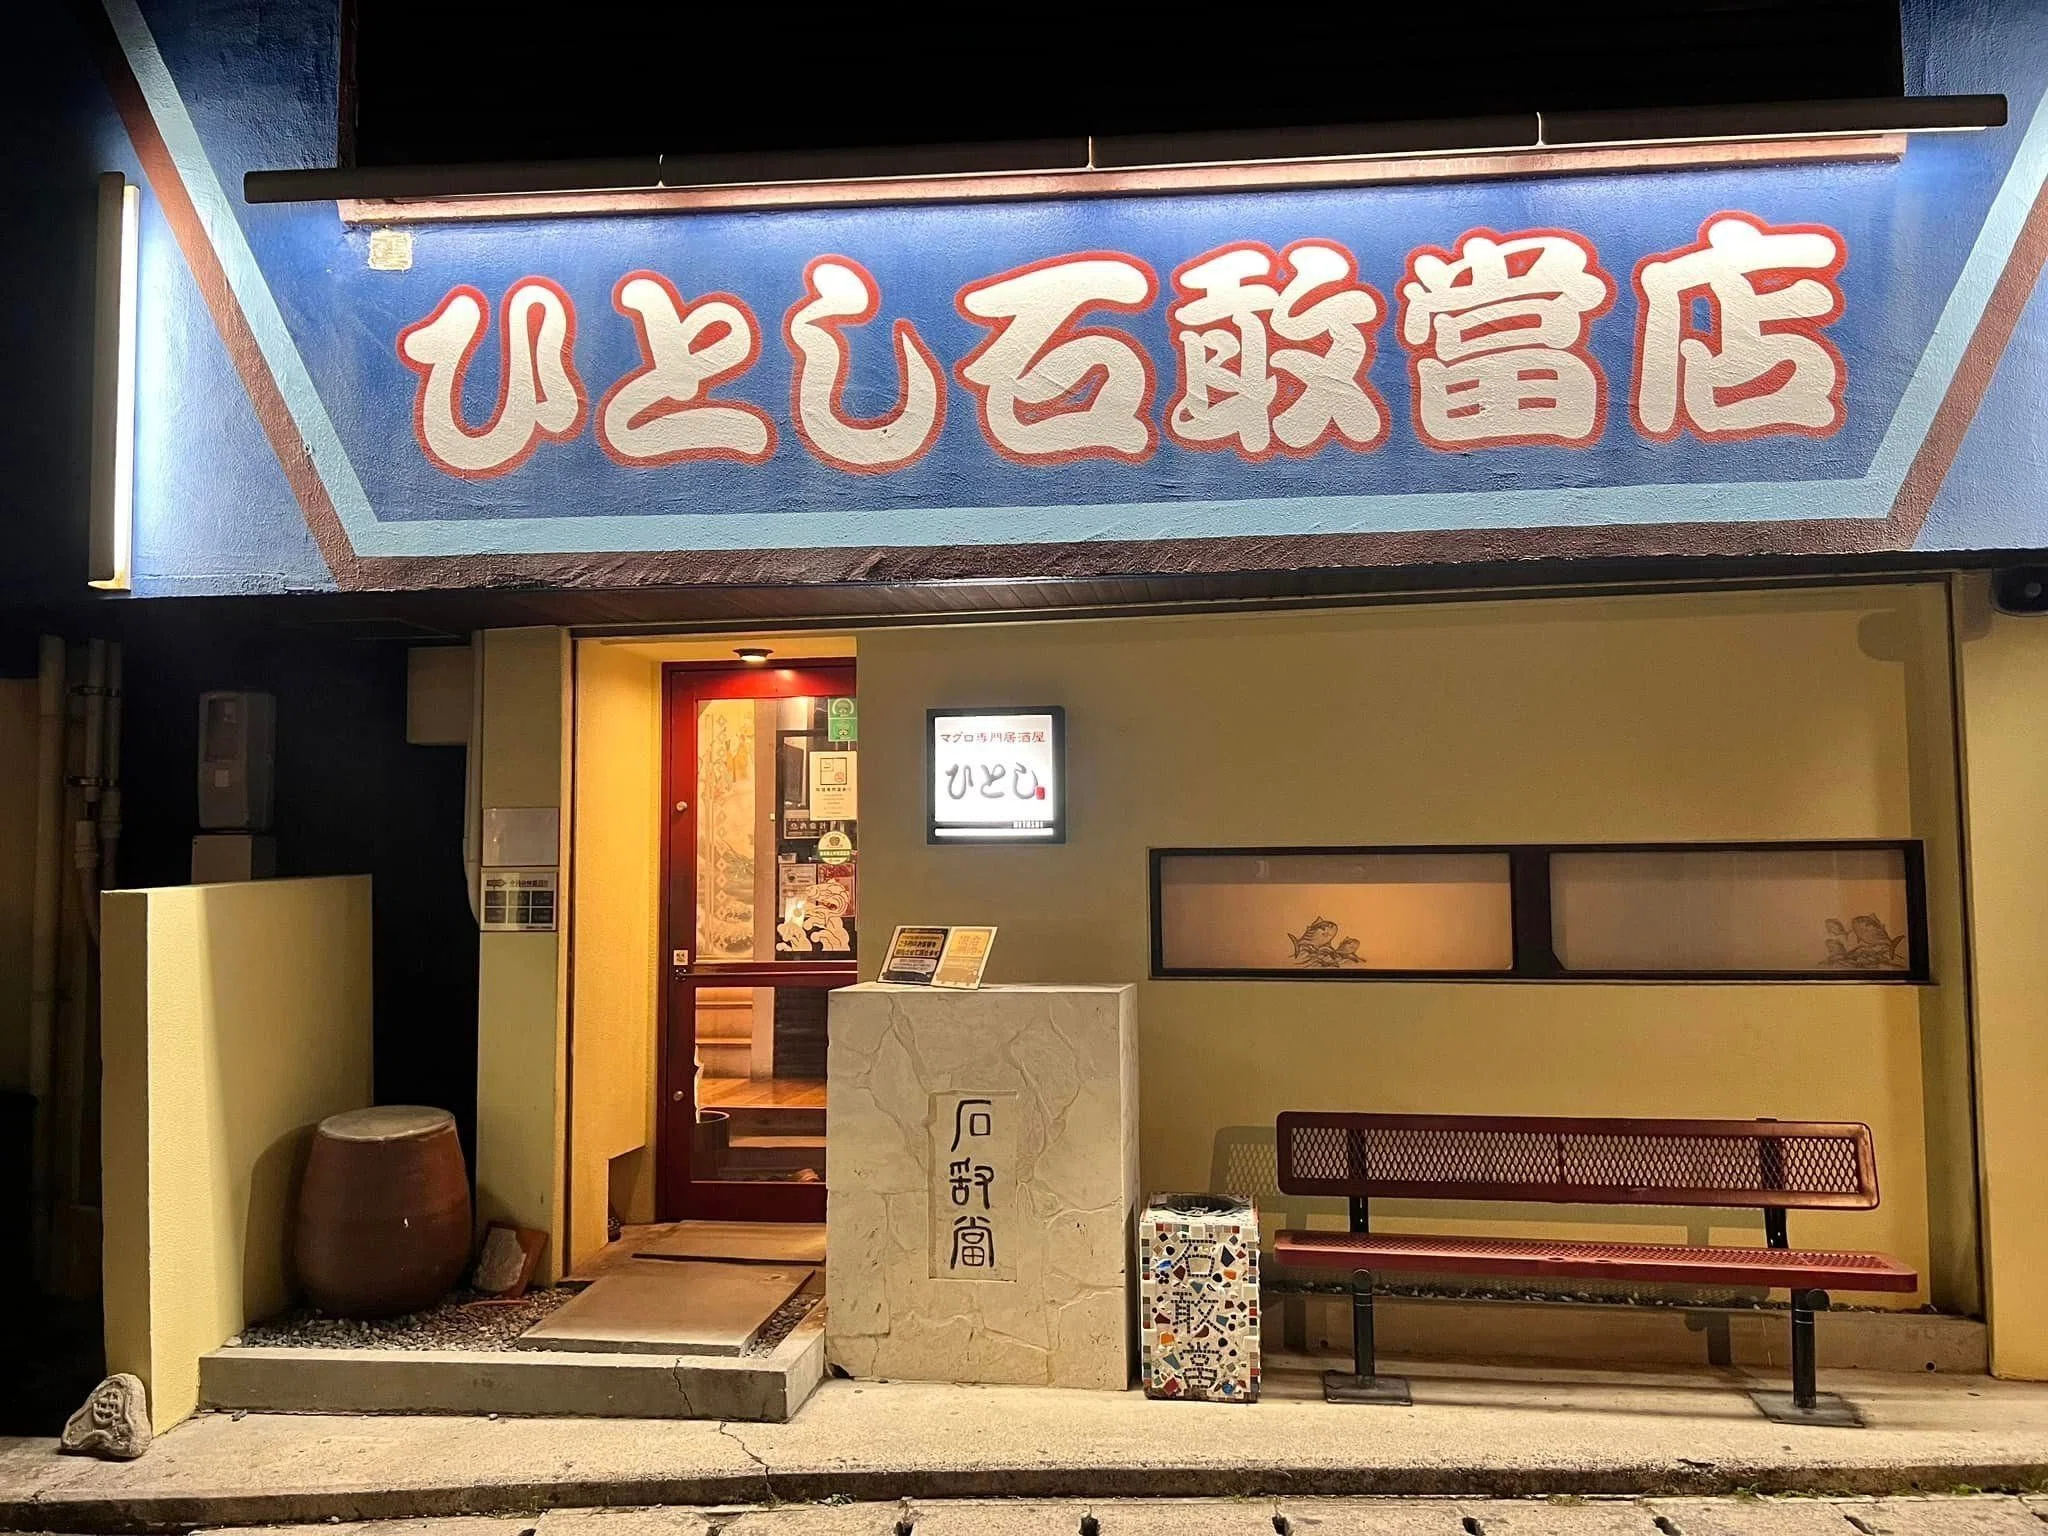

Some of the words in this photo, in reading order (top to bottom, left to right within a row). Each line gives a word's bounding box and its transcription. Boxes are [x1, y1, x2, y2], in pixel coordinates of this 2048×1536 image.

[939, 731, 1046, 744] マグロ専門居酒屋
[945, 761, 1039, 800] ひとし
